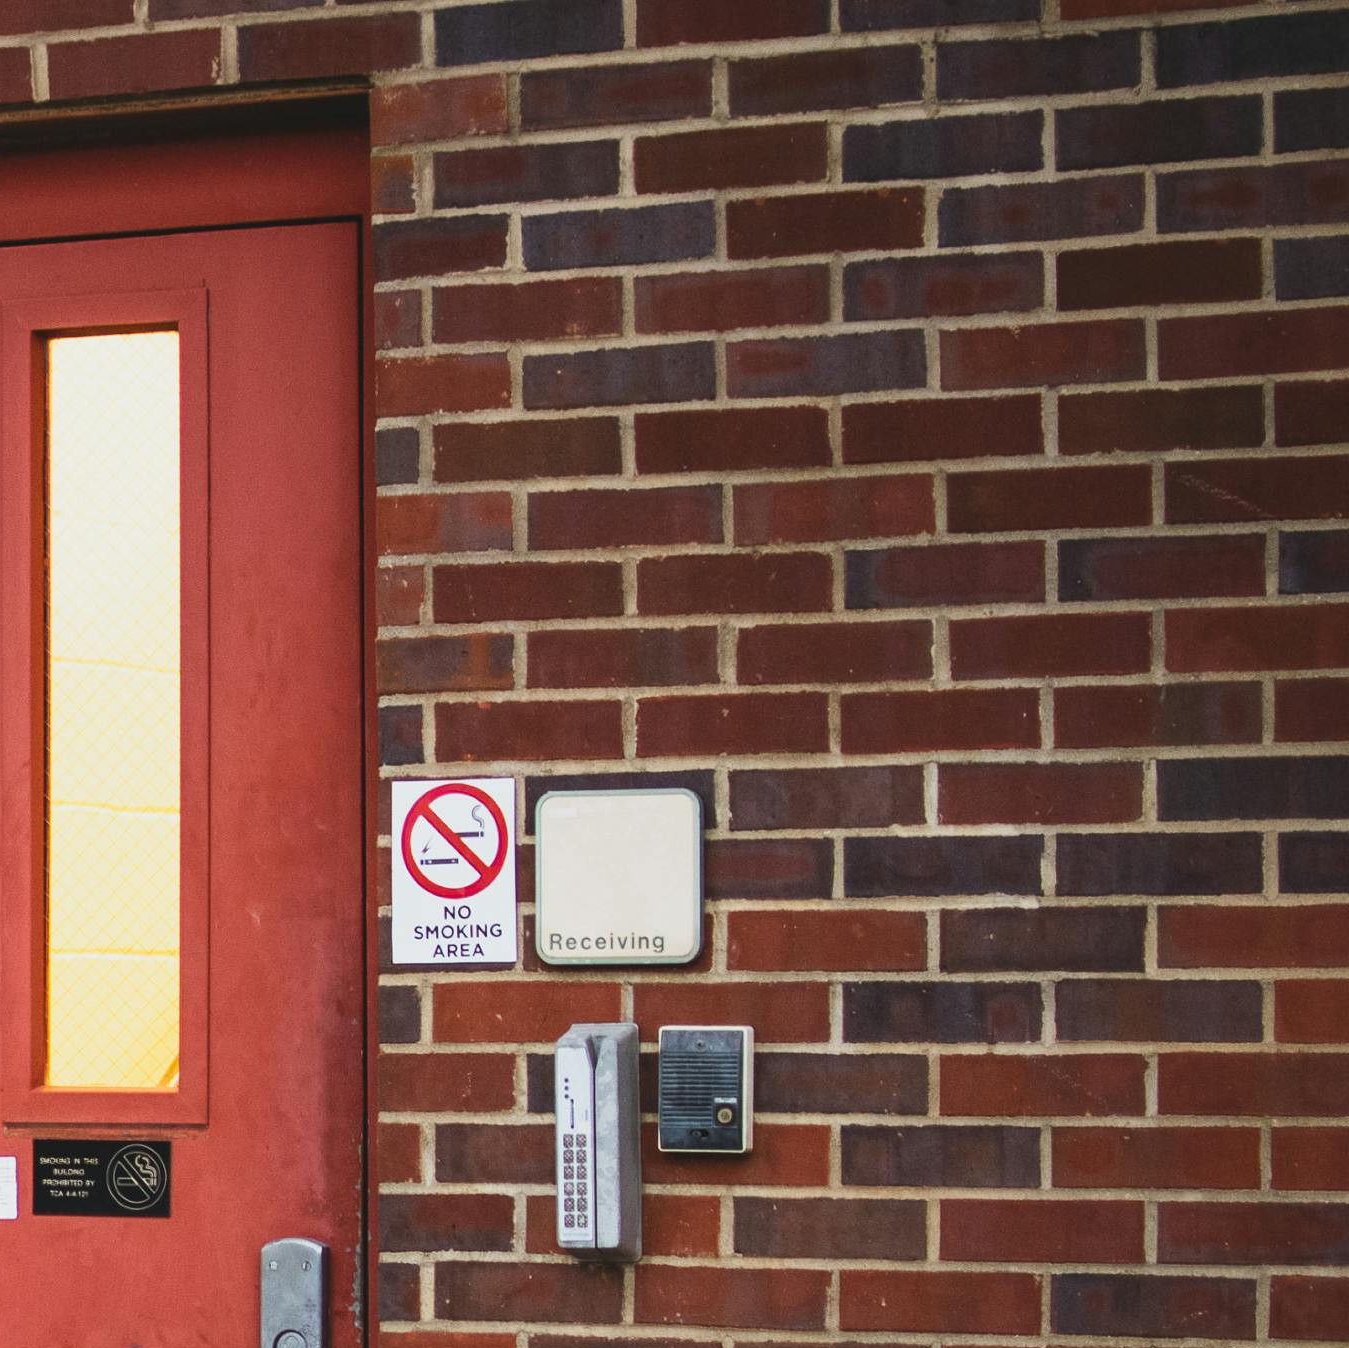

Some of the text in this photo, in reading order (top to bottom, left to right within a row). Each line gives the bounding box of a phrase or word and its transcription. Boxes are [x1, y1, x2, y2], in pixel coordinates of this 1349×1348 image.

[444, 905, 471, 919] NO
[414, 923, 502, 940] SMOKING
[549, 931, 665, 954] Receiving
[433, 943, 484, 958] AREA
[40, 1157, 70, 1165] SMOKING
[83, 1157, 98, 1166] THIS
[53, 1168, 85, 1176] BUILDING
[42, 1178, 95, 1187] PROHIBITED BY
